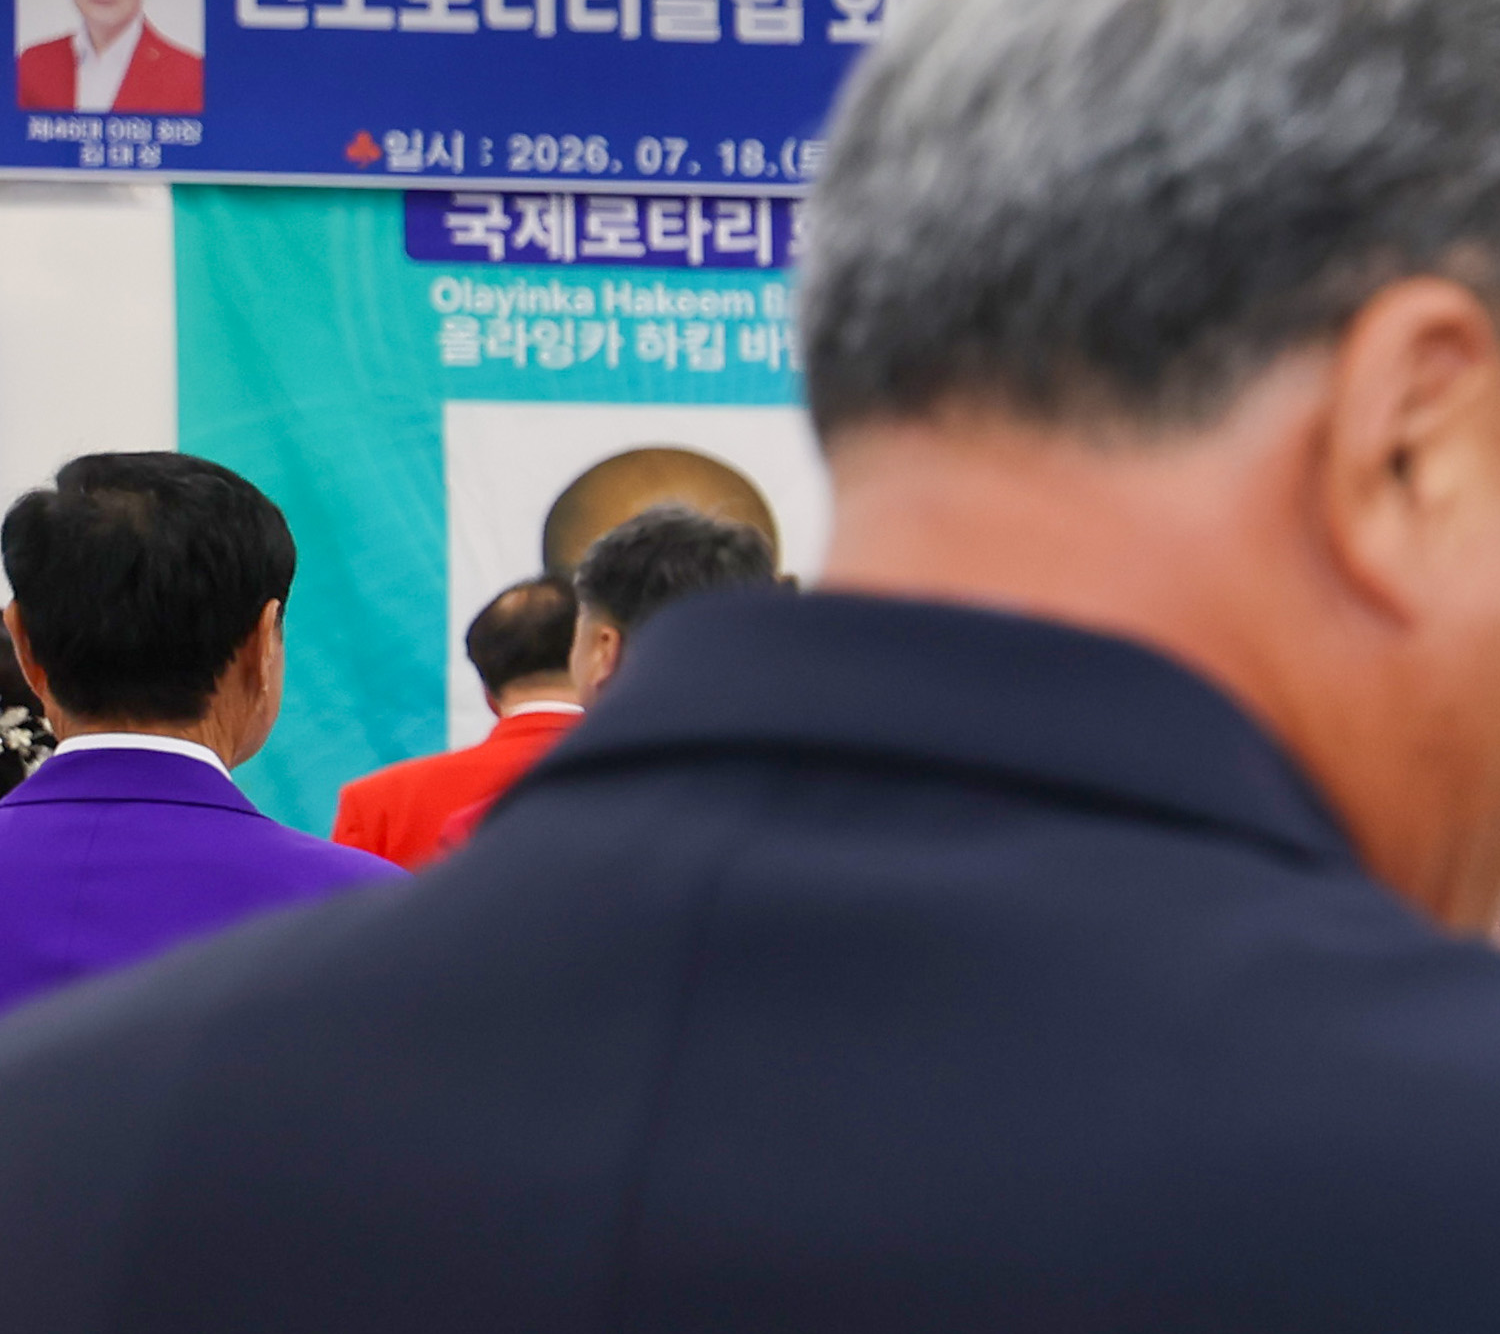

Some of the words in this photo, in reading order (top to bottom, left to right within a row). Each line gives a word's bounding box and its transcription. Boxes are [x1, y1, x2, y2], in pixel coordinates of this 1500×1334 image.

[382, 129, 464, 175] 일시
[507, 133, 623, 175] 2026.
[636, 136, 701, 176] 07.
[444, 193, 774, 267] 국제로타리
[431, 276, 597, 321] Olayinka
